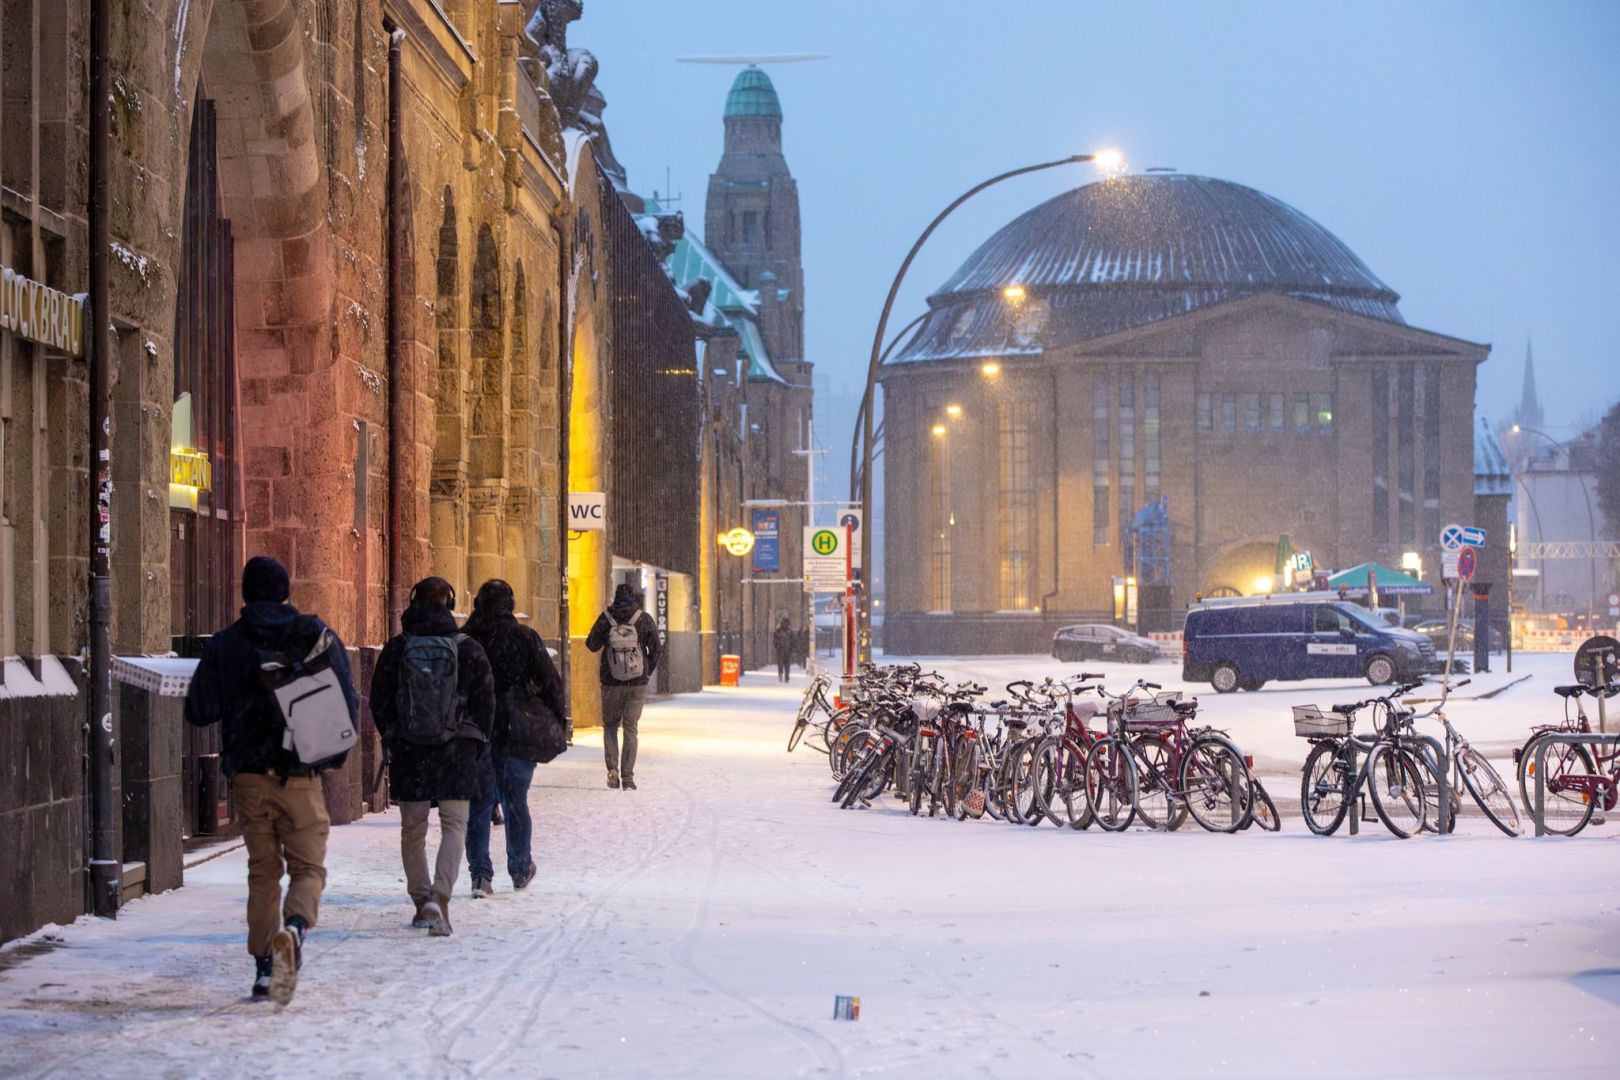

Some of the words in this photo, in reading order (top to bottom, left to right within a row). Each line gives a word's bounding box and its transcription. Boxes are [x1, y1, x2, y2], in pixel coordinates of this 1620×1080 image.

[570, 504, 602, 519] WC
[819, 535, 831, 550] H
[658, 592, 667, 646] AUTOMAT
